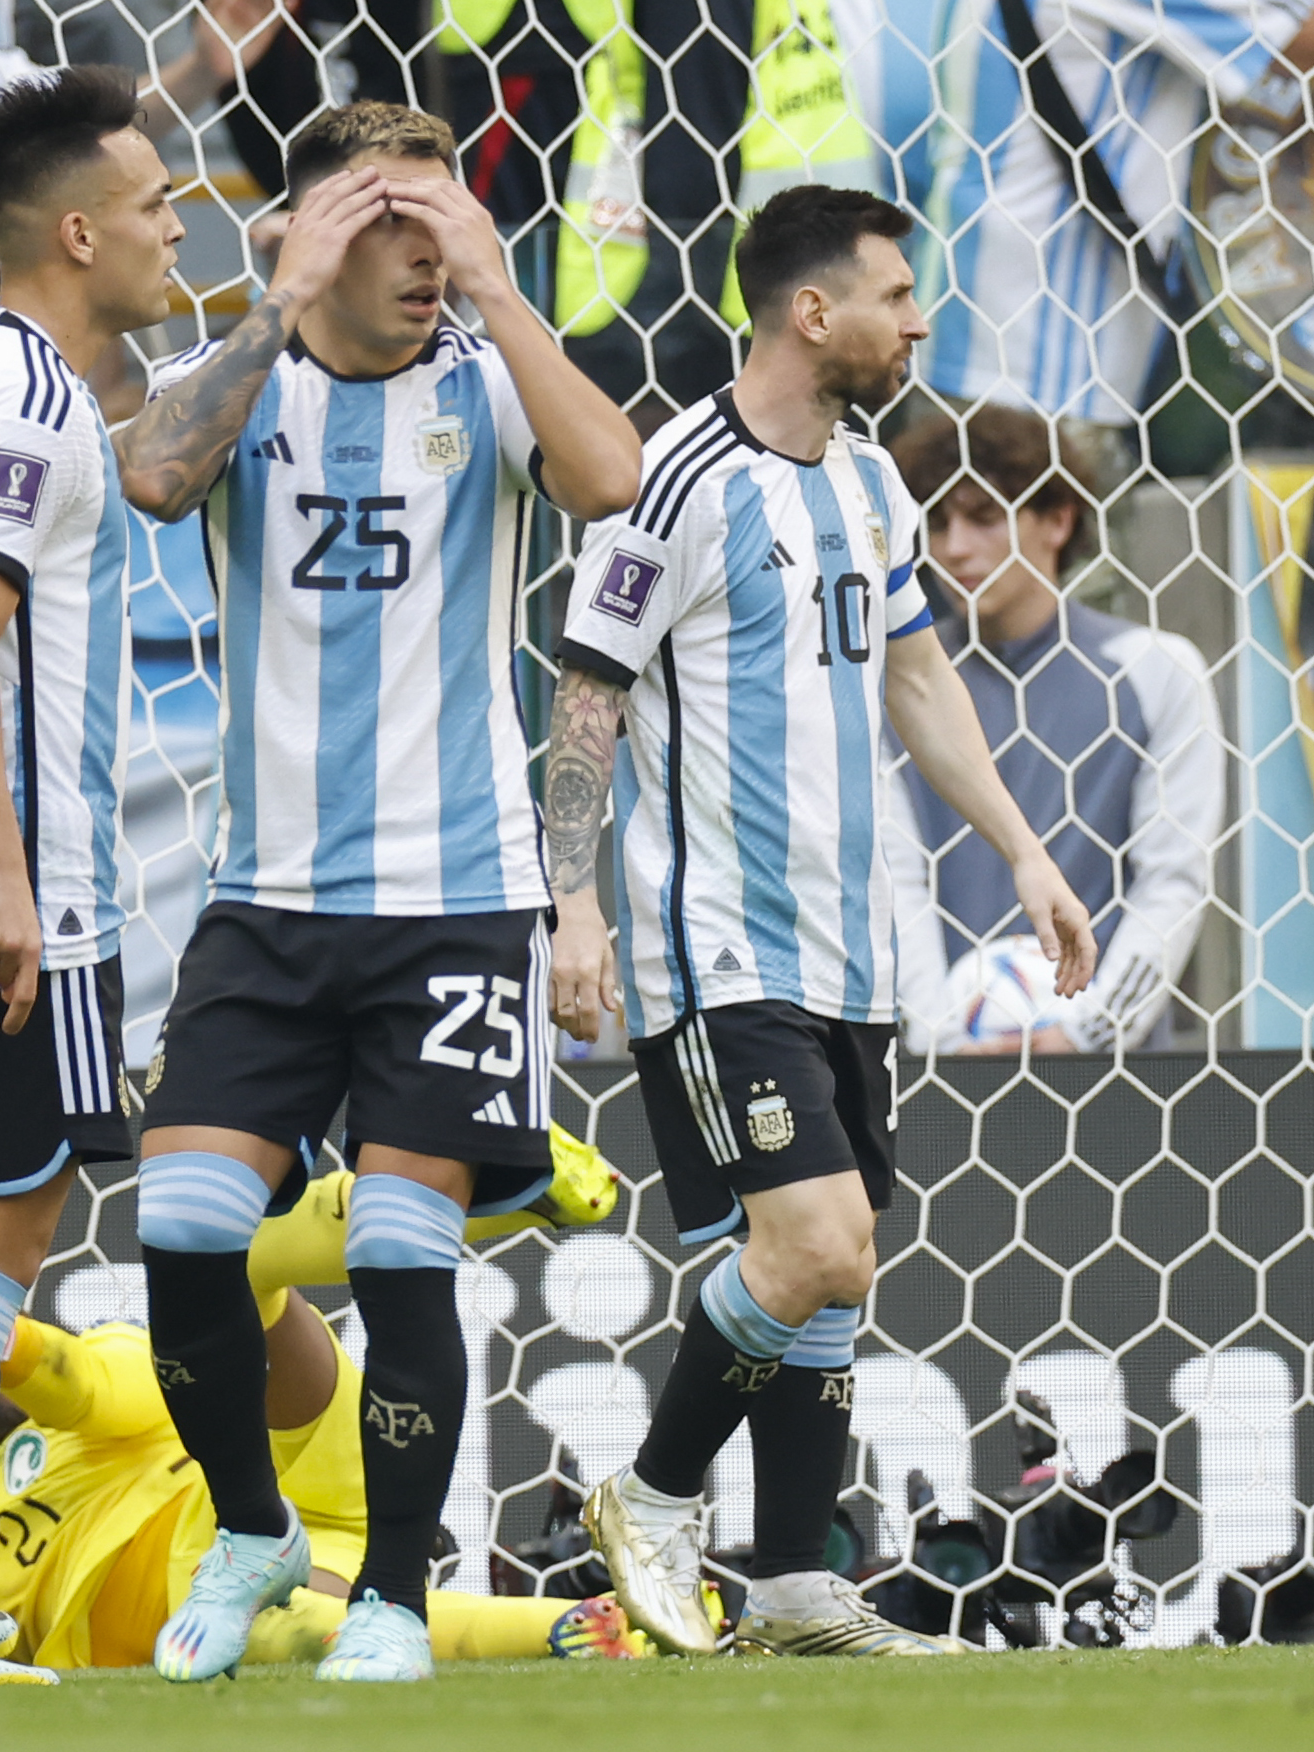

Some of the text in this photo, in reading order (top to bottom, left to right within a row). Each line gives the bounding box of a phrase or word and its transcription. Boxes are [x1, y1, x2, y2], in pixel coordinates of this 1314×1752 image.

[292, 493, 411, 592] 25
[811, 573, 870, 666] 10
[420, 974, 524, 1079] 25
[364, 1388, 436, 1449] AFA
